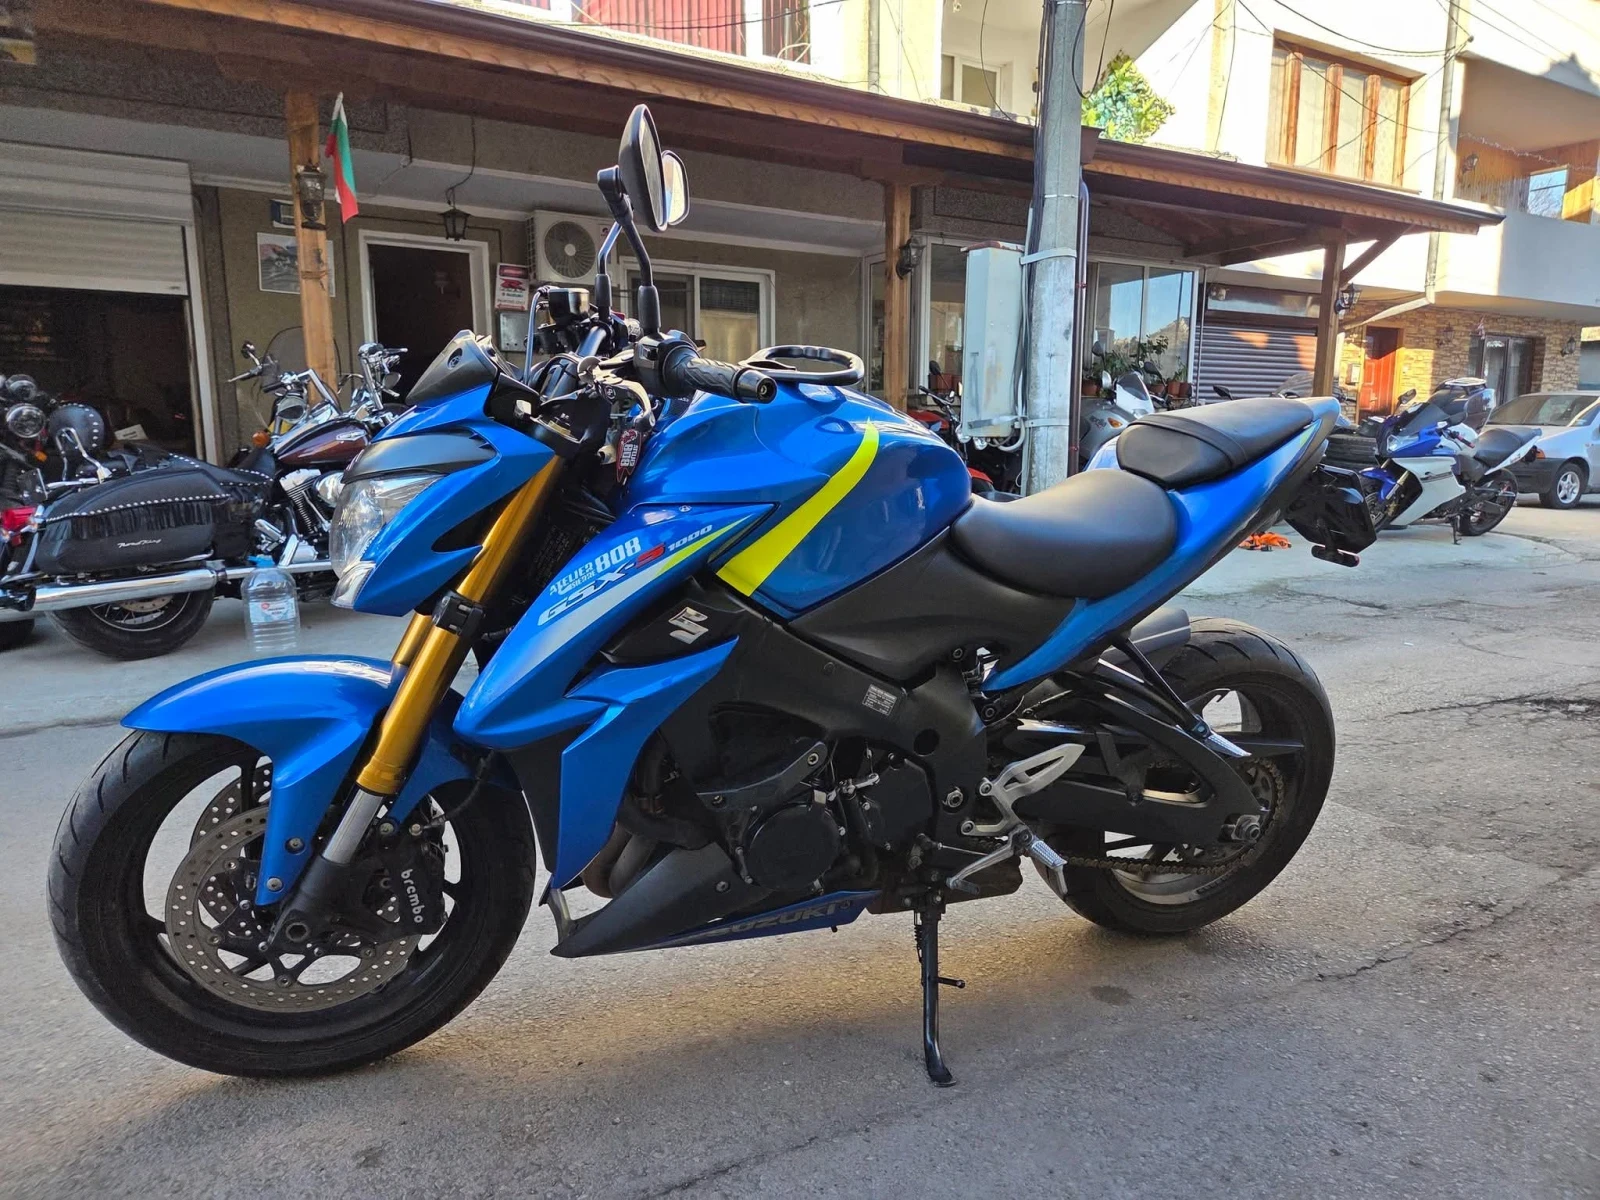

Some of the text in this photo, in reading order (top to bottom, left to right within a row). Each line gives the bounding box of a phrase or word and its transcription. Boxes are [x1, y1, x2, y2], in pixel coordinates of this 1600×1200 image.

[595, 536, 642, 574] 808
[668, 524, 713, 552] 1000
[549, 561, 596, 597] ATELIER
[401, 868, 425, 923] brembo
